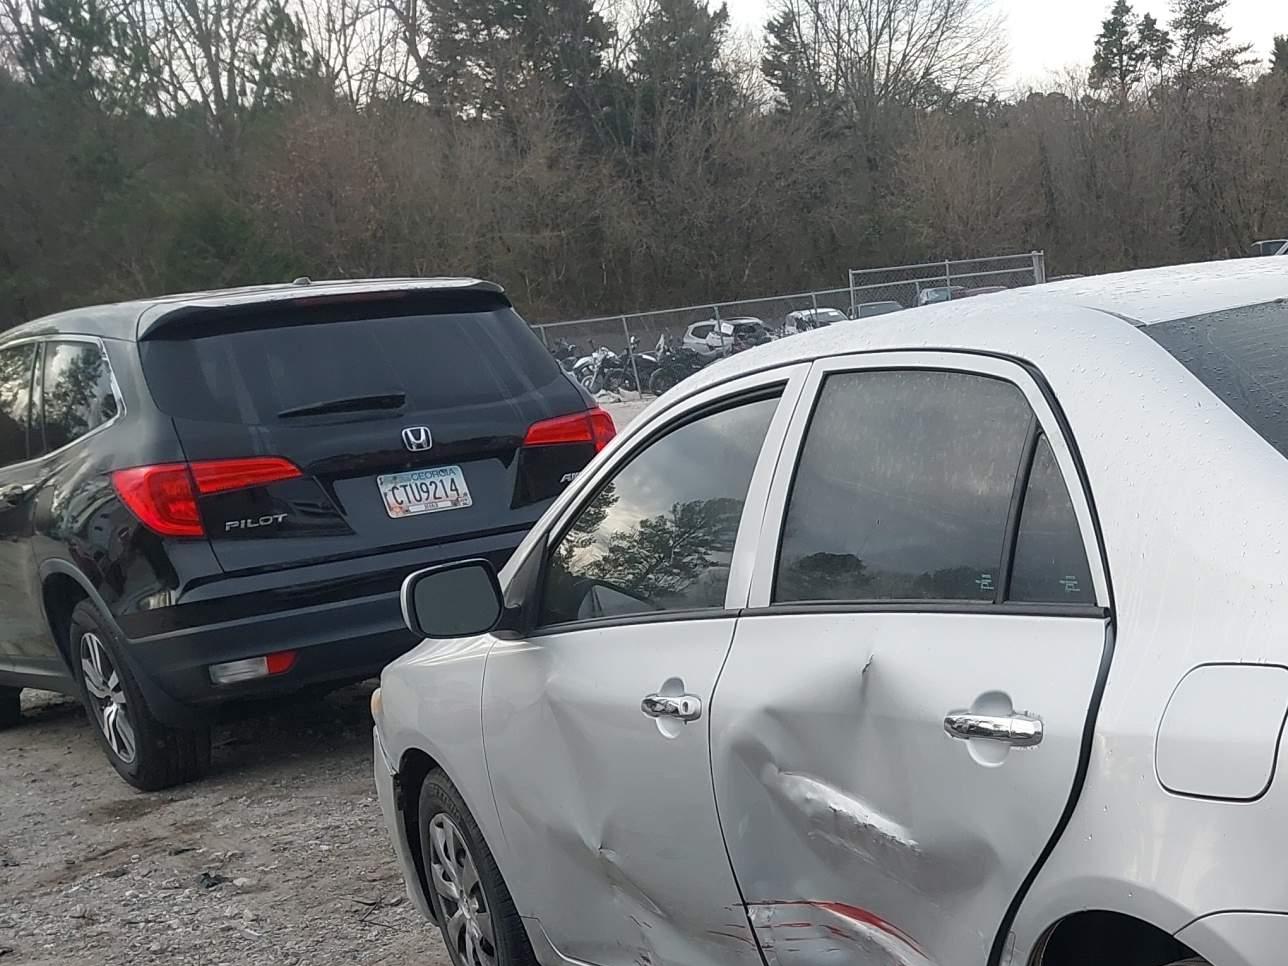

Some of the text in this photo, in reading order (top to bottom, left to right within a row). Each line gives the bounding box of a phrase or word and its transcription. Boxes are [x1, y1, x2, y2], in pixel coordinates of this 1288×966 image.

[411, 467, 456, 481] GEORGIA
[391, 477, 460, 506] CTU9214
[225, 513, 288, 531] PILOT
